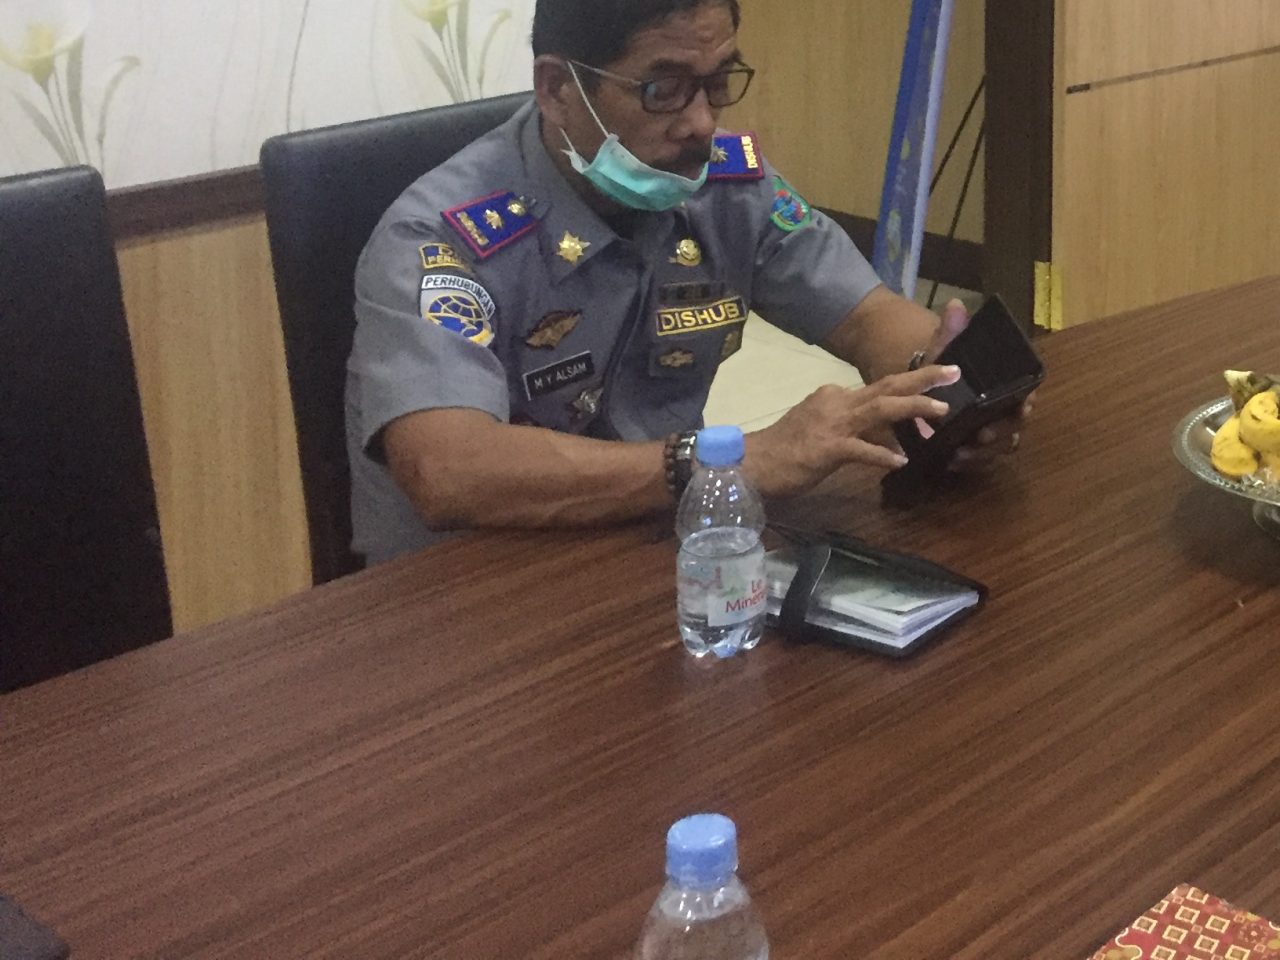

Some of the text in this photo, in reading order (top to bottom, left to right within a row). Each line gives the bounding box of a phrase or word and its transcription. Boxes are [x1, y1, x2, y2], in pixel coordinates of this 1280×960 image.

[424, 276, 494, 319] PERHUBUNGAN
[661, 303, 740, 330] DISHUB
[534, 378, 543, 390] M
